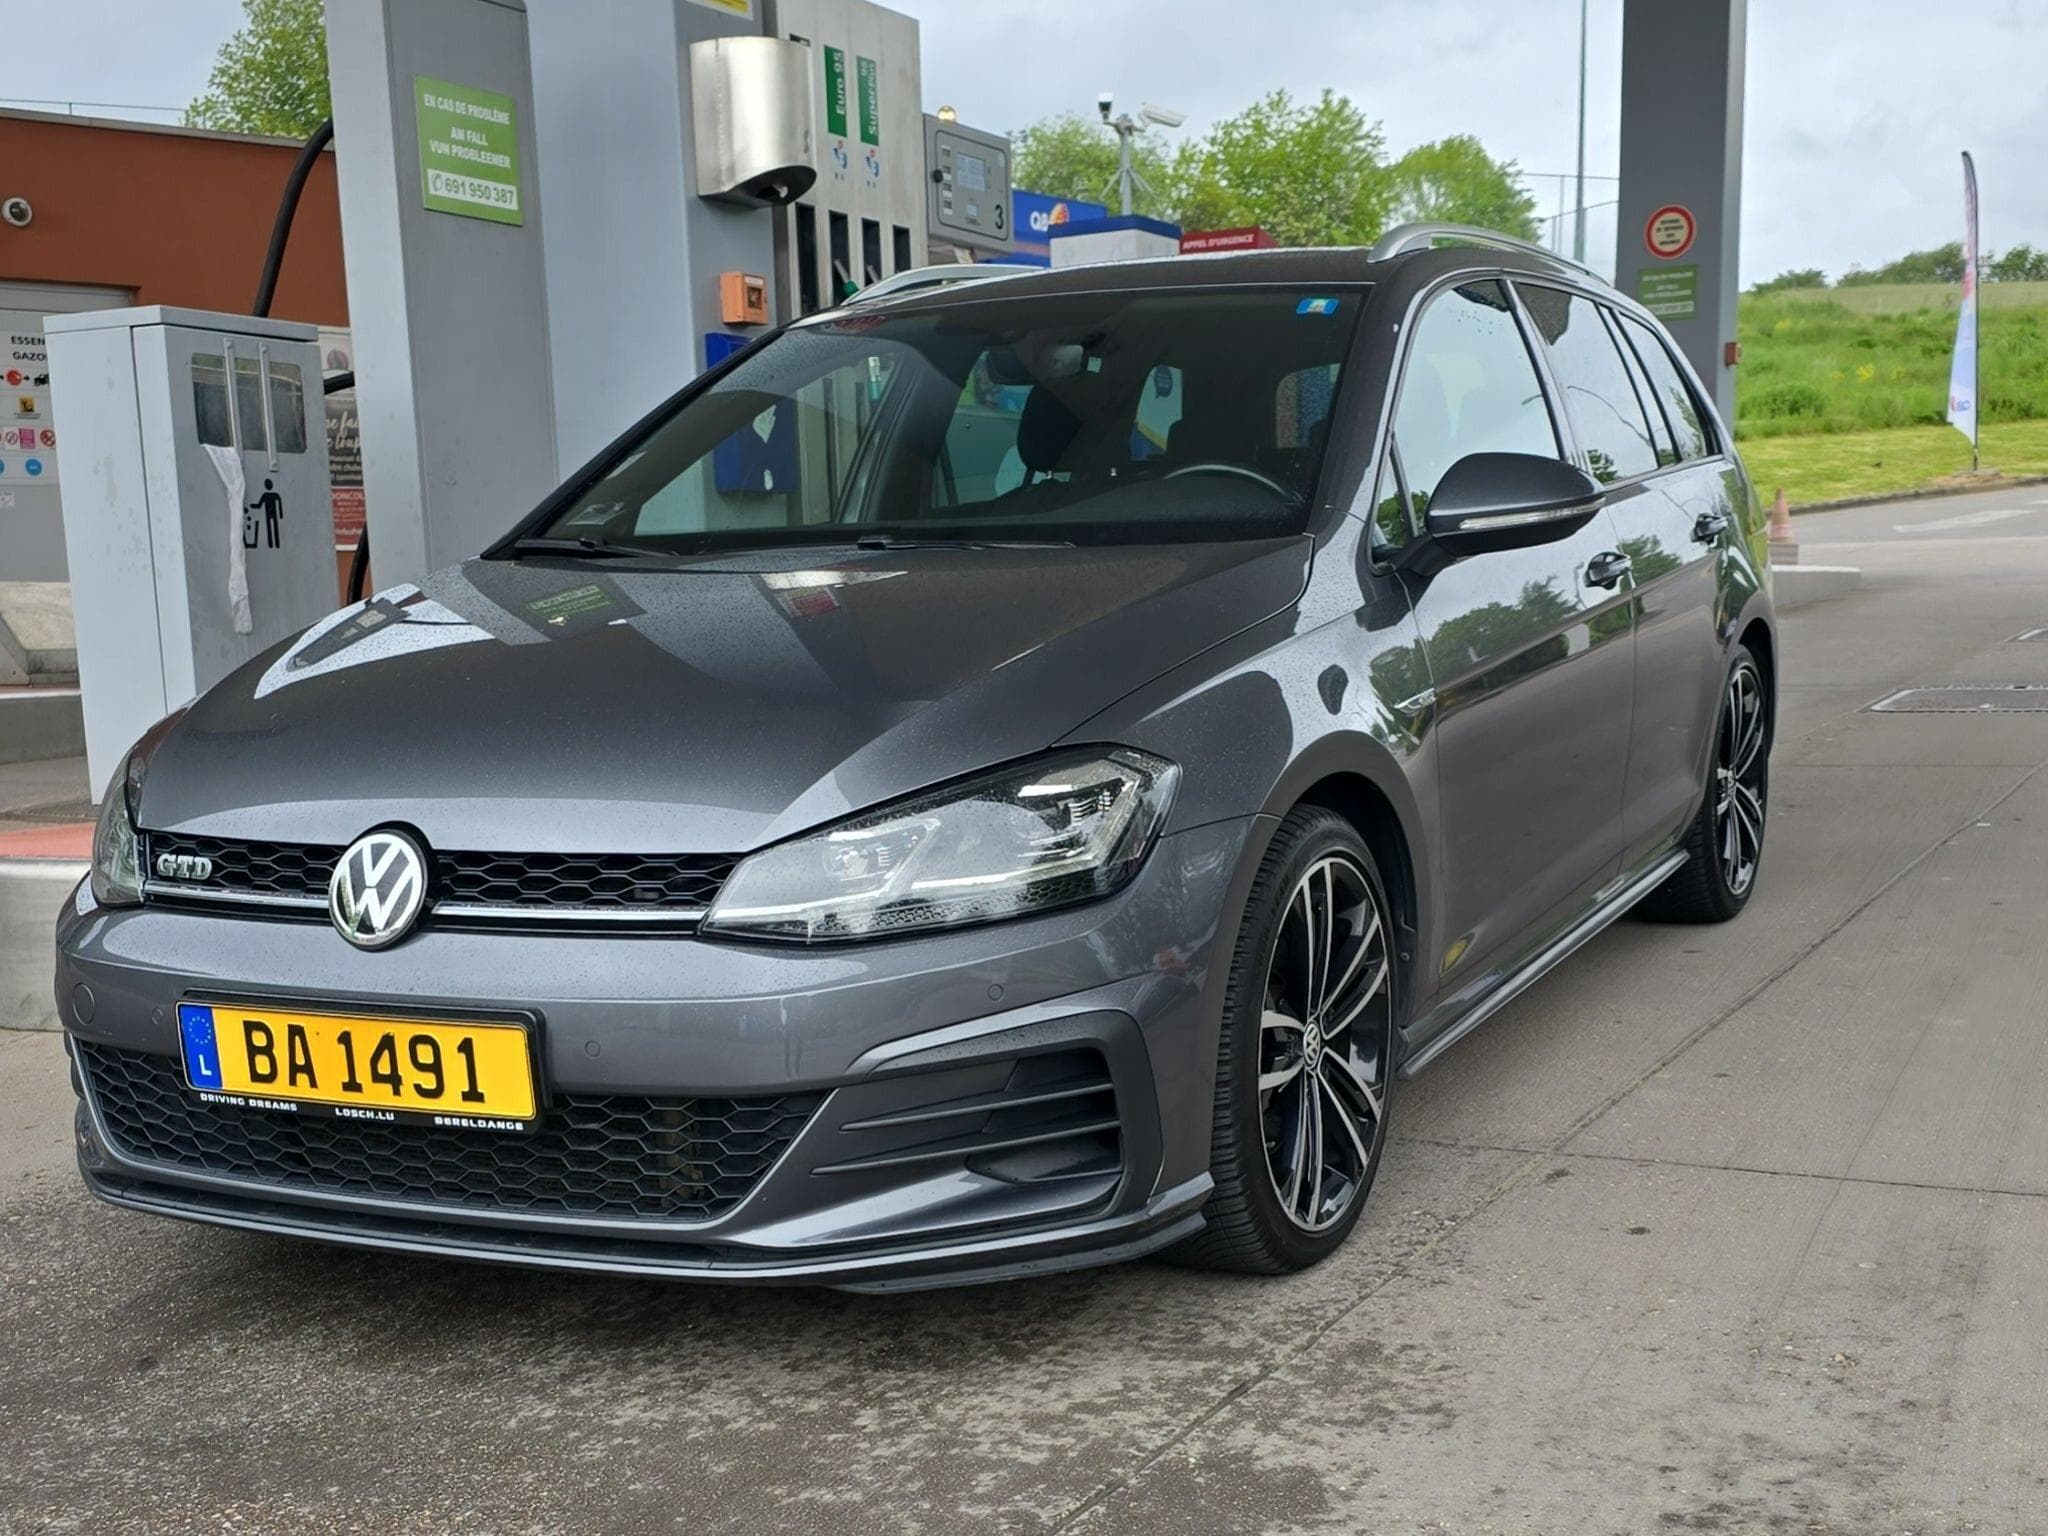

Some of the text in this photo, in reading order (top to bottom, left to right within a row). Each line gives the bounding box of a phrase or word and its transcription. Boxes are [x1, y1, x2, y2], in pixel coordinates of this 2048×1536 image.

[833, 50, 845, 115] Euro 95
[424, 93, 436, 108] EN
[437, 97, 454, 112] CAS
[455, 101, 467, 115] DE
[428, 139, 450, 155] VUN
[450, 126, 488, 146] AM FALL
[445, 177, 514, 205] 691 950 387
[995, 204, 1004, 230] 3
[1182, 239, 1207, 250] APPEL
[157, 853, 212, 880] GTD
[199, 1054, 212, 1076] L
[243, 1020, 485, 1103] BA 1491
[200, 1093, 298, 1112] DRIVING DREAMS
[335, 1107, 395, 1121] LOSCH.LU
[434, 1115, 524, 1131] BERELDANGE
